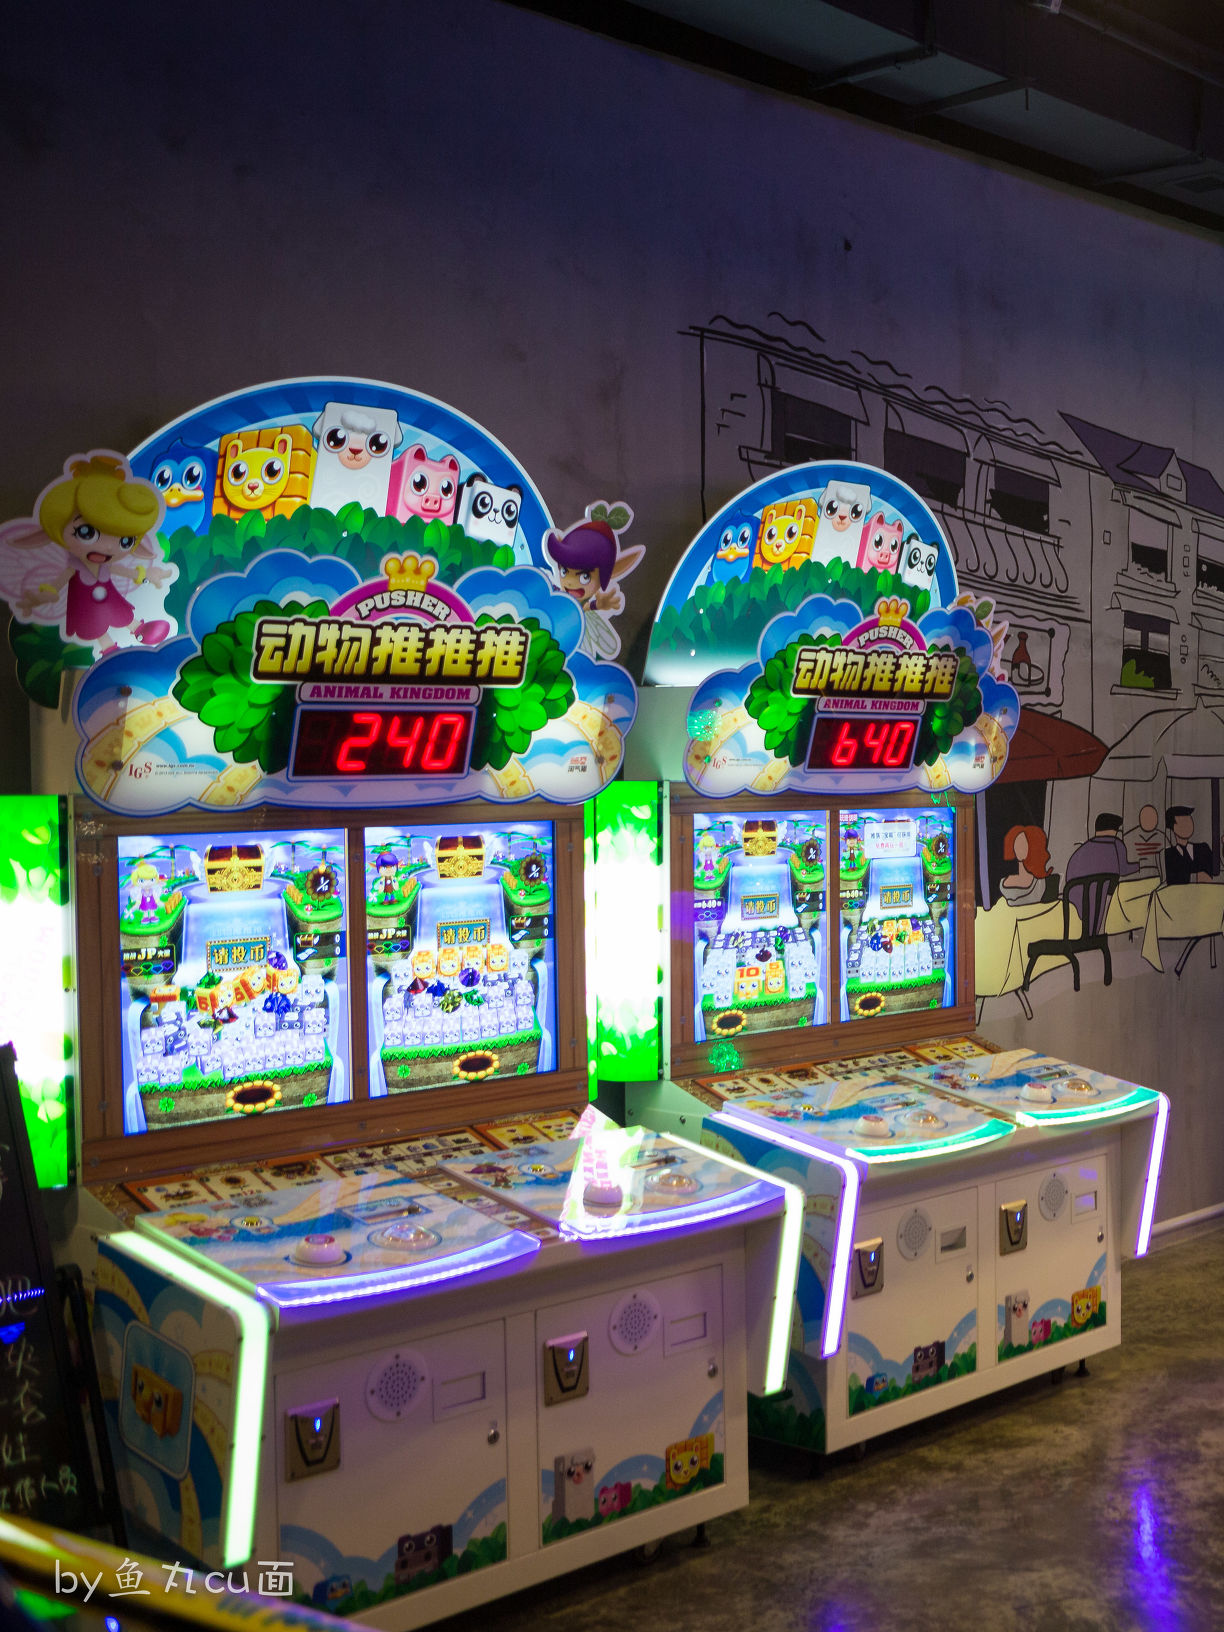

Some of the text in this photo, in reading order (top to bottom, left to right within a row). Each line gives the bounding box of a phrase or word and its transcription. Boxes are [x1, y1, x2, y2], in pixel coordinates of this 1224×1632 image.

[356, 589, 452, 621] PUSHER
[858, 625, 915, 650] PUSHER
[256, 621, 527, 679] 动物推推推
[795, 650, 956, 694] 动物推推推
[309, 684, 472, 701] ANIMAL KINGDOM
[823, 698, 920, 712] ANIMAL KINGDOM
[335, 712, 466, 772] 240
[830, 721, 915, 766] 640
[128, 760, 153, 780] IGS
[712, 755, 728, 769] IGS
[745, 899, 776, 915] 请投币
[442, 925, 487, 945] 请投币
[213, 944, 266, 966] 请投币
[738, 966, 761, 979] 10
